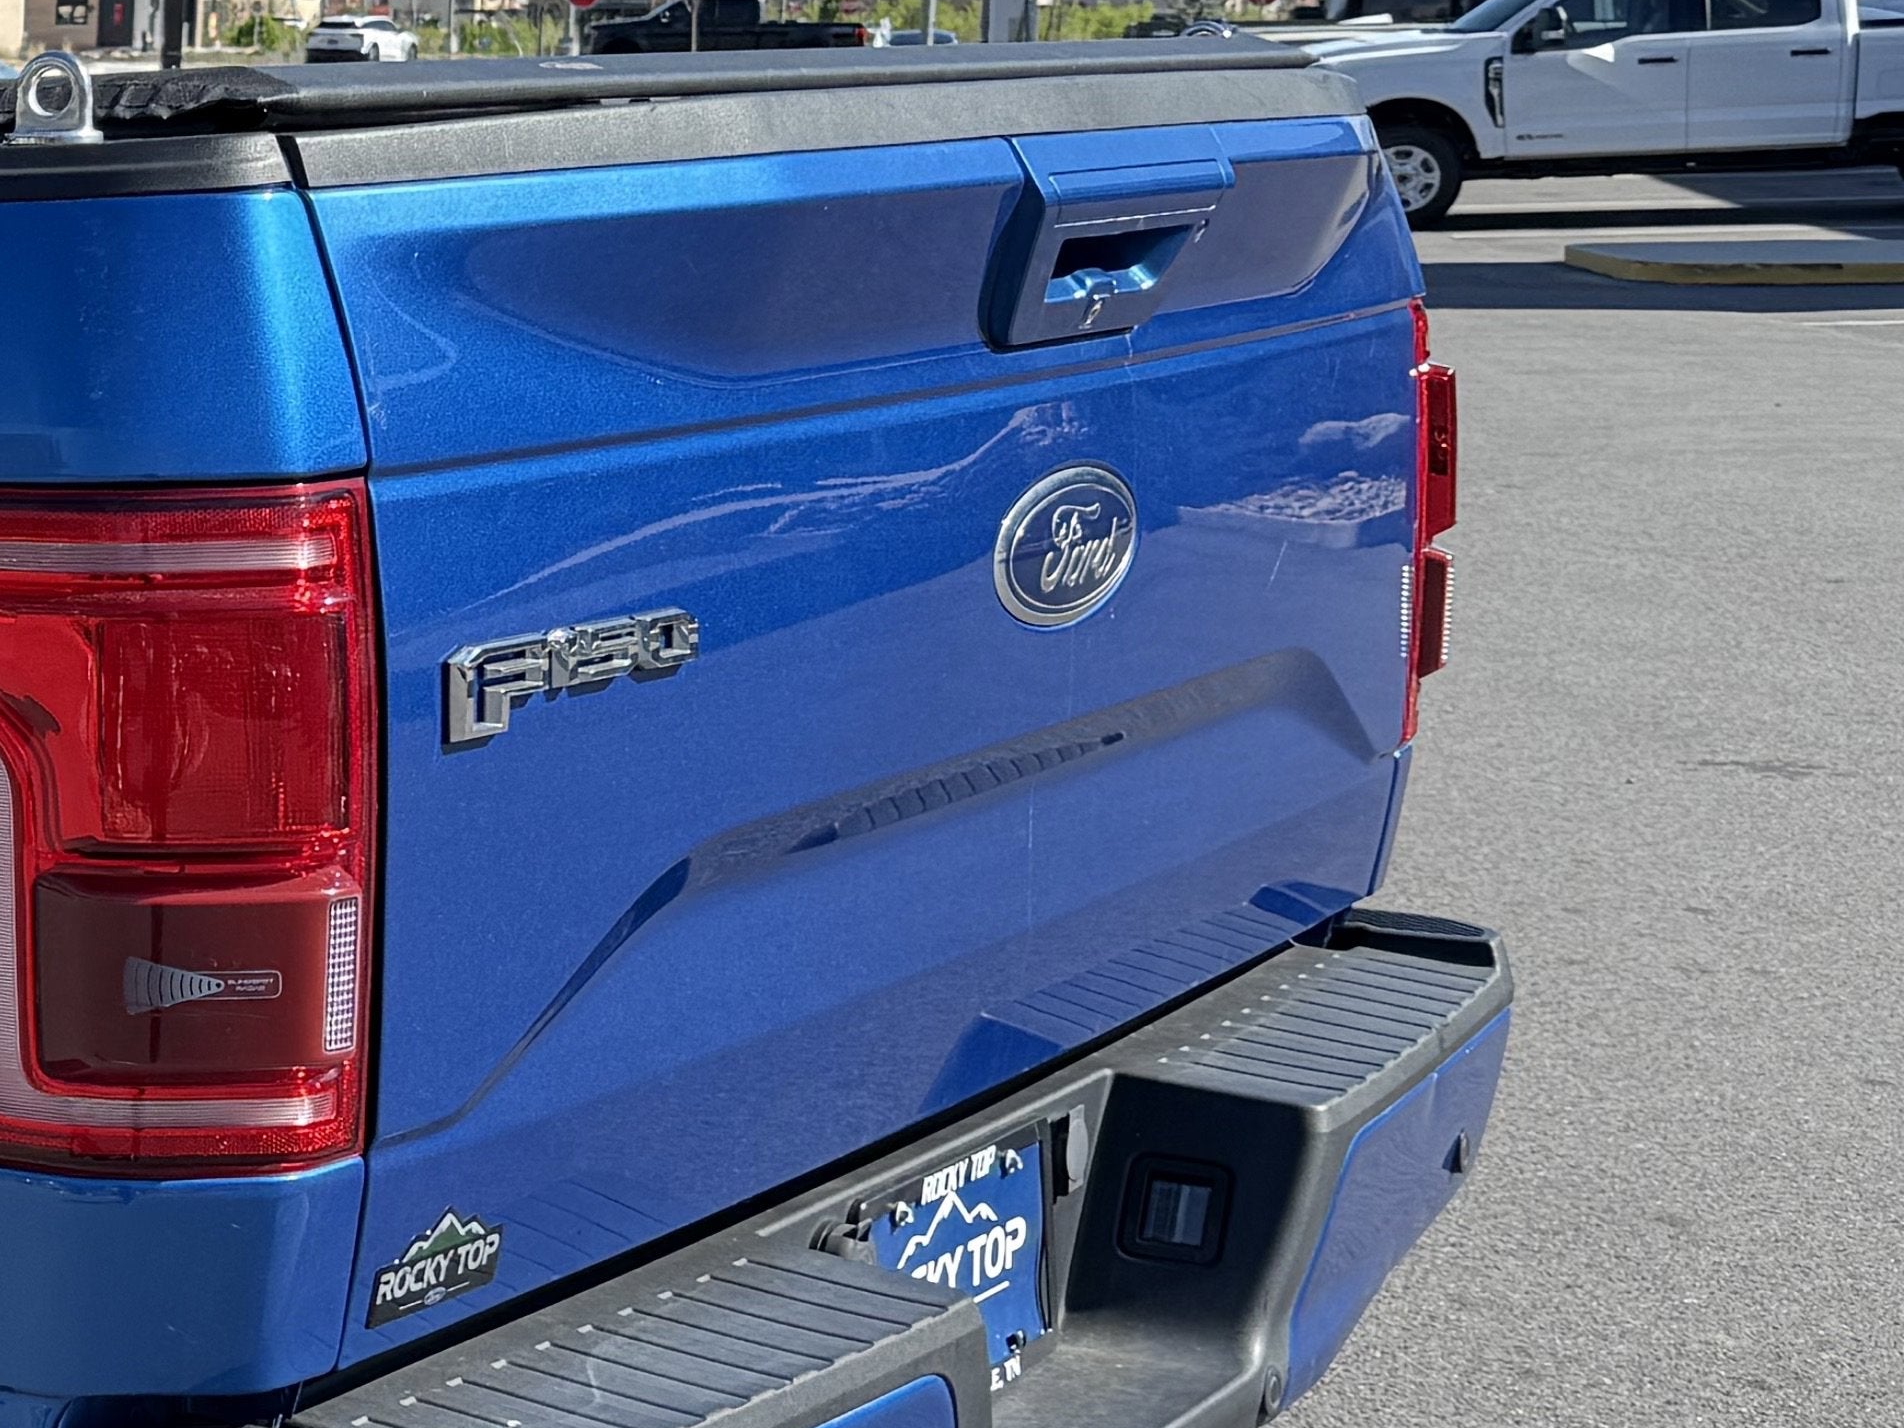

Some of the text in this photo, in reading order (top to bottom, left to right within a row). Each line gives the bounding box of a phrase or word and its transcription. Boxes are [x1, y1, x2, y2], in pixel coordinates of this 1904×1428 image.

[1040, 501, 1117, 594] Ford
[920, 1144, 996, 1205] ROCKY TOP
[375, 1233, 500, 1305] ROCKY TOP
[966, 1216, 1027, 1287] TOP
